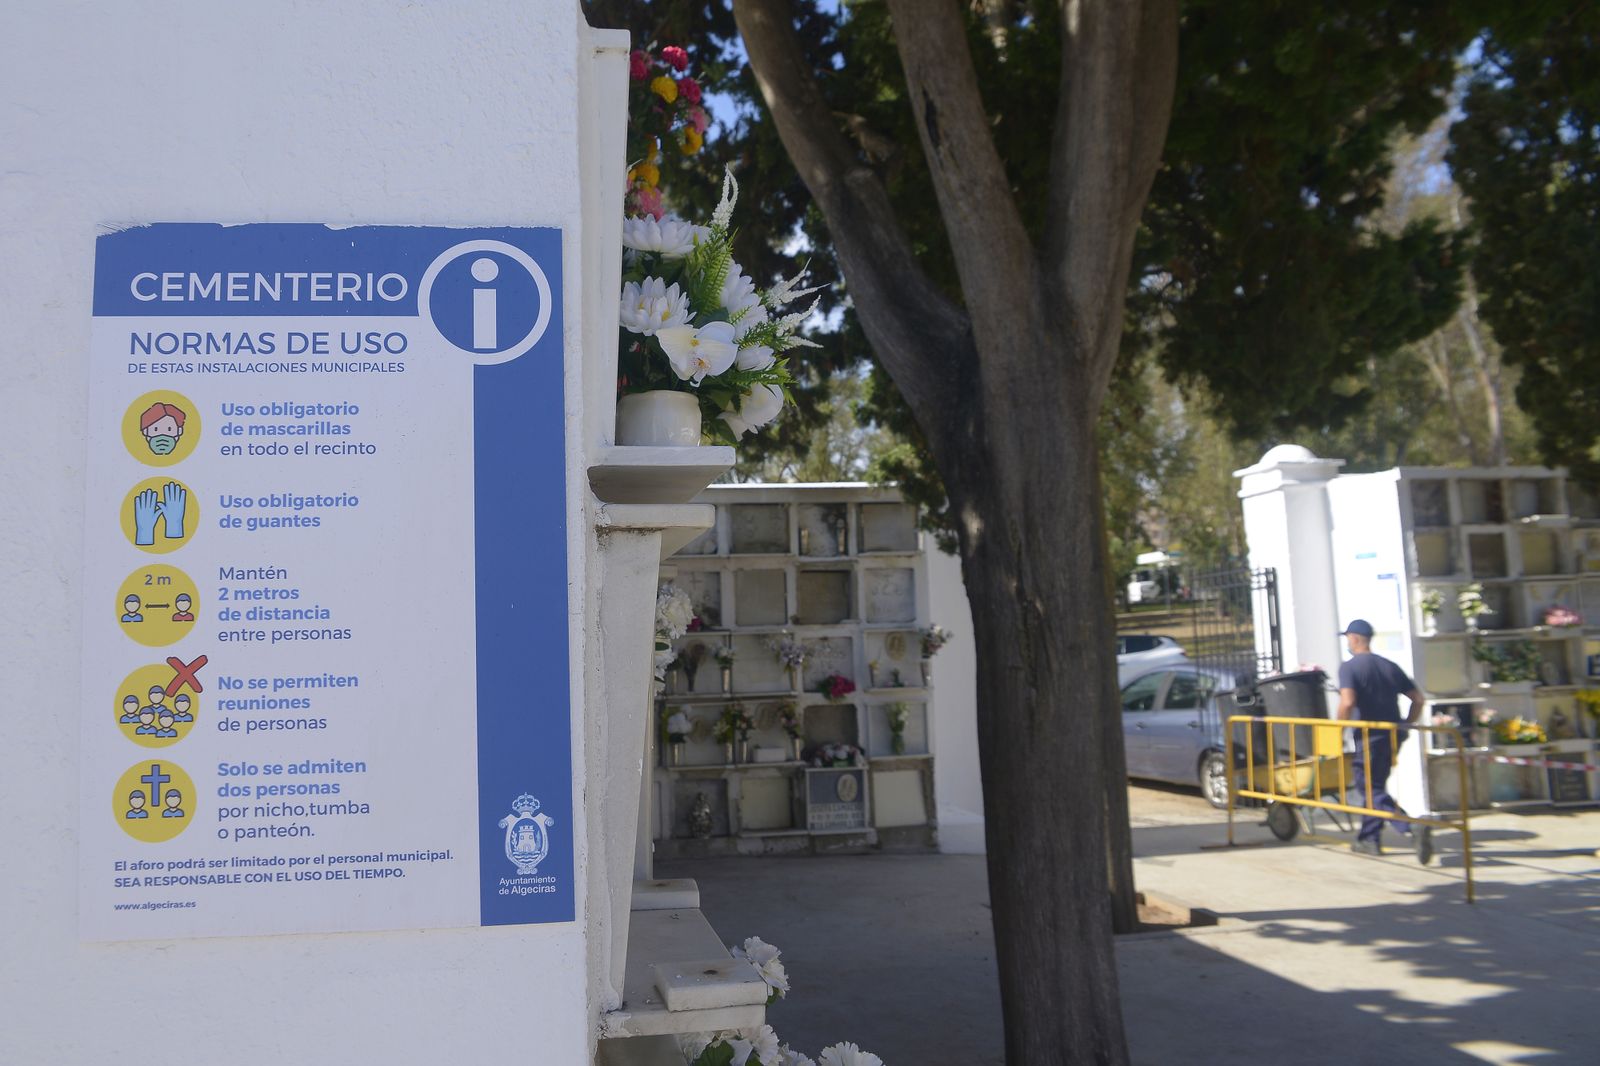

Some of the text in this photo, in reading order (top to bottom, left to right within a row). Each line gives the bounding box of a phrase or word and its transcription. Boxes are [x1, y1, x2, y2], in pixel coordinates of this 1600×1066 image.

[131, 273, 408, 301] CEMENTERIO
[131, 332, 407, 354] NORMAS DE USO
[128, 362, 404, 373] DE ESTAS INSTALACIONES MUNICIPALES
[222, 401, 359, 418] Uso obligatorio
[221, 421, 350, 435] de mascarillas
[221, 441, 376, 455] en todo el recinto
[220, 493, 359, 510] Uso obligatorio
[219, 514, 320, 531] de guantes
[145, 574, 171, 586] 2 m
[220, 566, 286, 580] Mantén
[219, 588, 299, 600] 2 metros
[218, 605, 330, 621] de distancia
[218, 629, 351, 644] entre personas
[219, 673, 358, 692] No se permiten
[218, 695, 310, 710] reuniones
[218, 717, 326, 734] de personas
[218, 759, 366, 776] Solo se admiten
[218, 782, 340, 799] dos personas
[219, 800, 369, 822] por nicho,tumba
[218, 823, 314, 842] o panteón.
[115, 850, 453, 871] El aforo podrá ser limitado por el personal municipal.
[115, 868, 405, 887] SEA RESPONSABLE CON EL USO DEL TIEMPO.
[499, 876, 556, 887] Ayuntamiento
[499, 884, 556, 896] de Algeciras
[114, 901, 196, 911] www.algeciras.es
